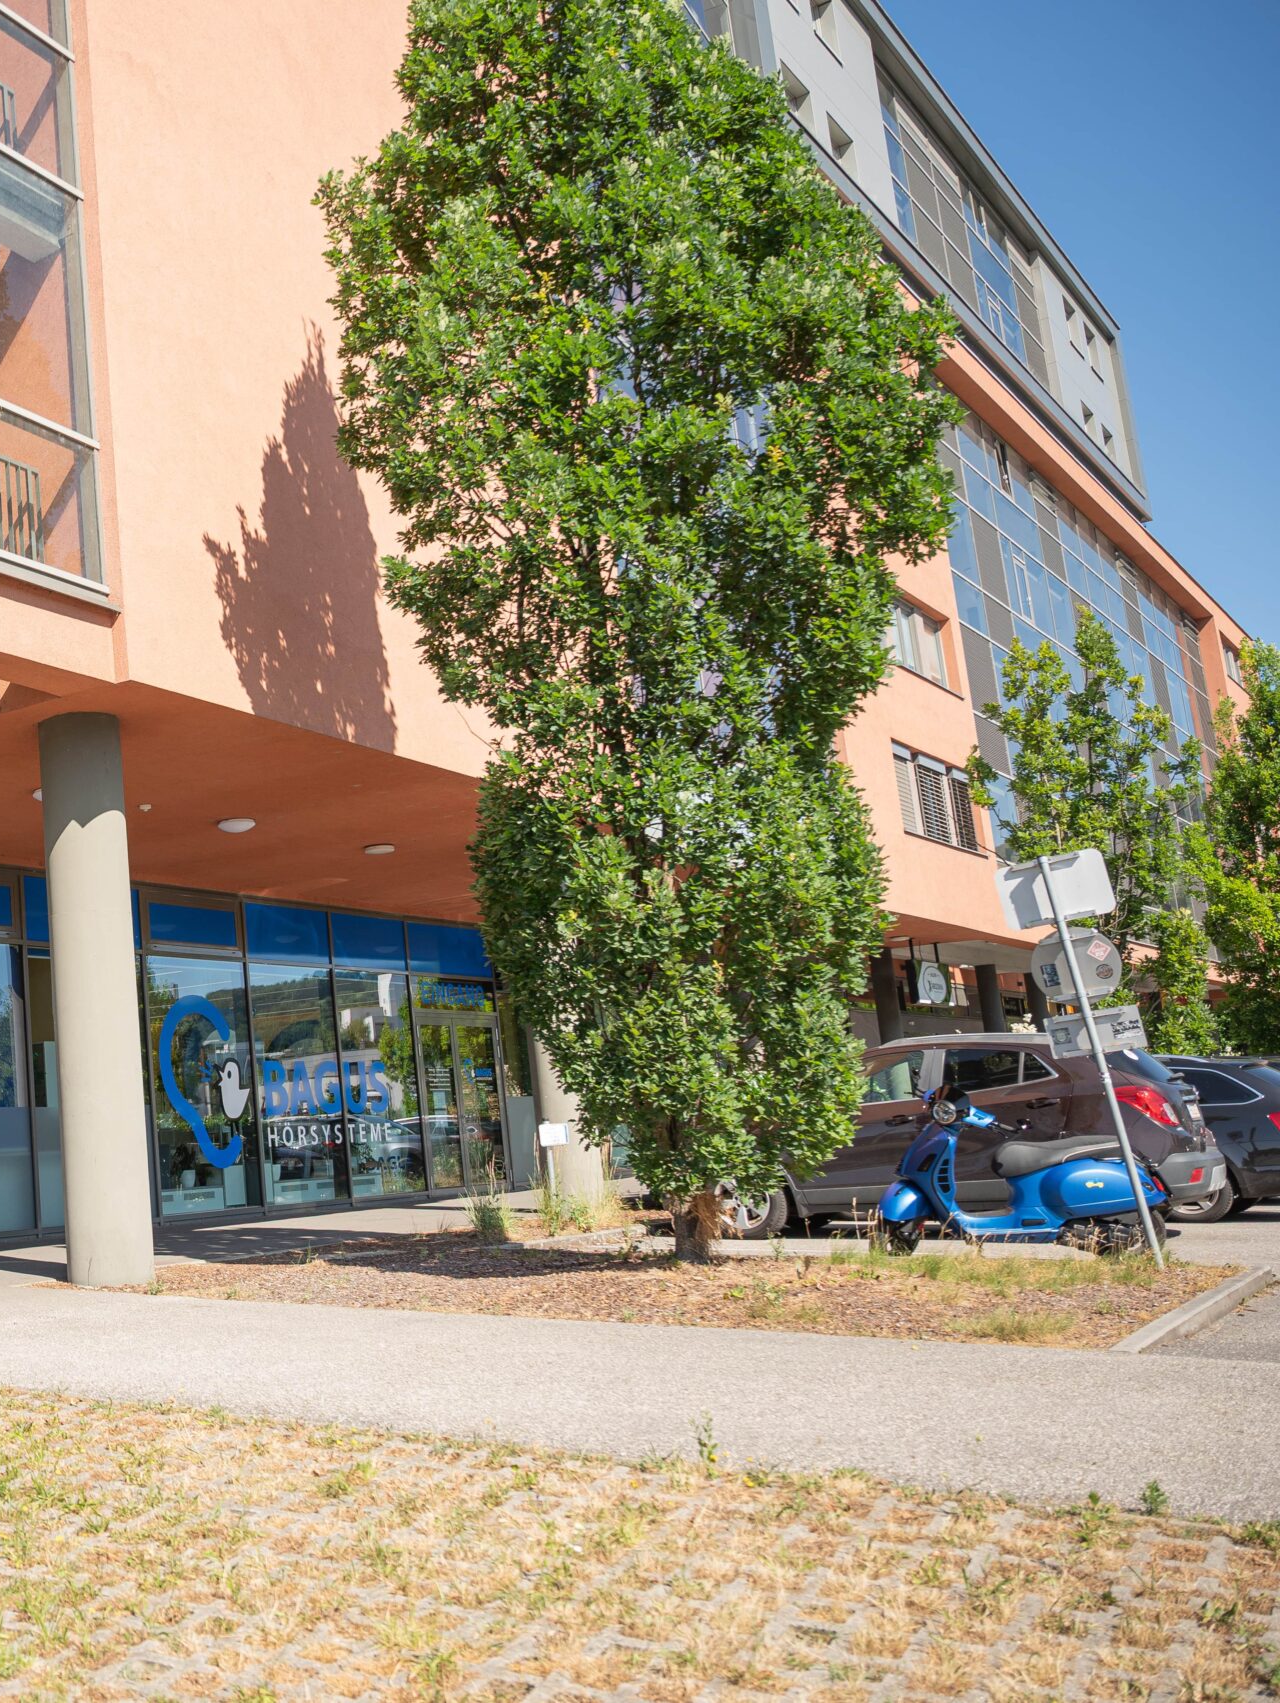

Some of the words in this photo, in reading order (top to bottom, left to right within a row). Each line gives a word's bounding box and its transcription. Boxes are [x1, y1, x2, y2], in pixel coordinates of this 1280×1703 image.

[421, 981, 485, 1007] EINGANG
[262, 1060, 389, 1116] BAGUS
[267, 1122, 393, 1148] HÖRSYSTEME
